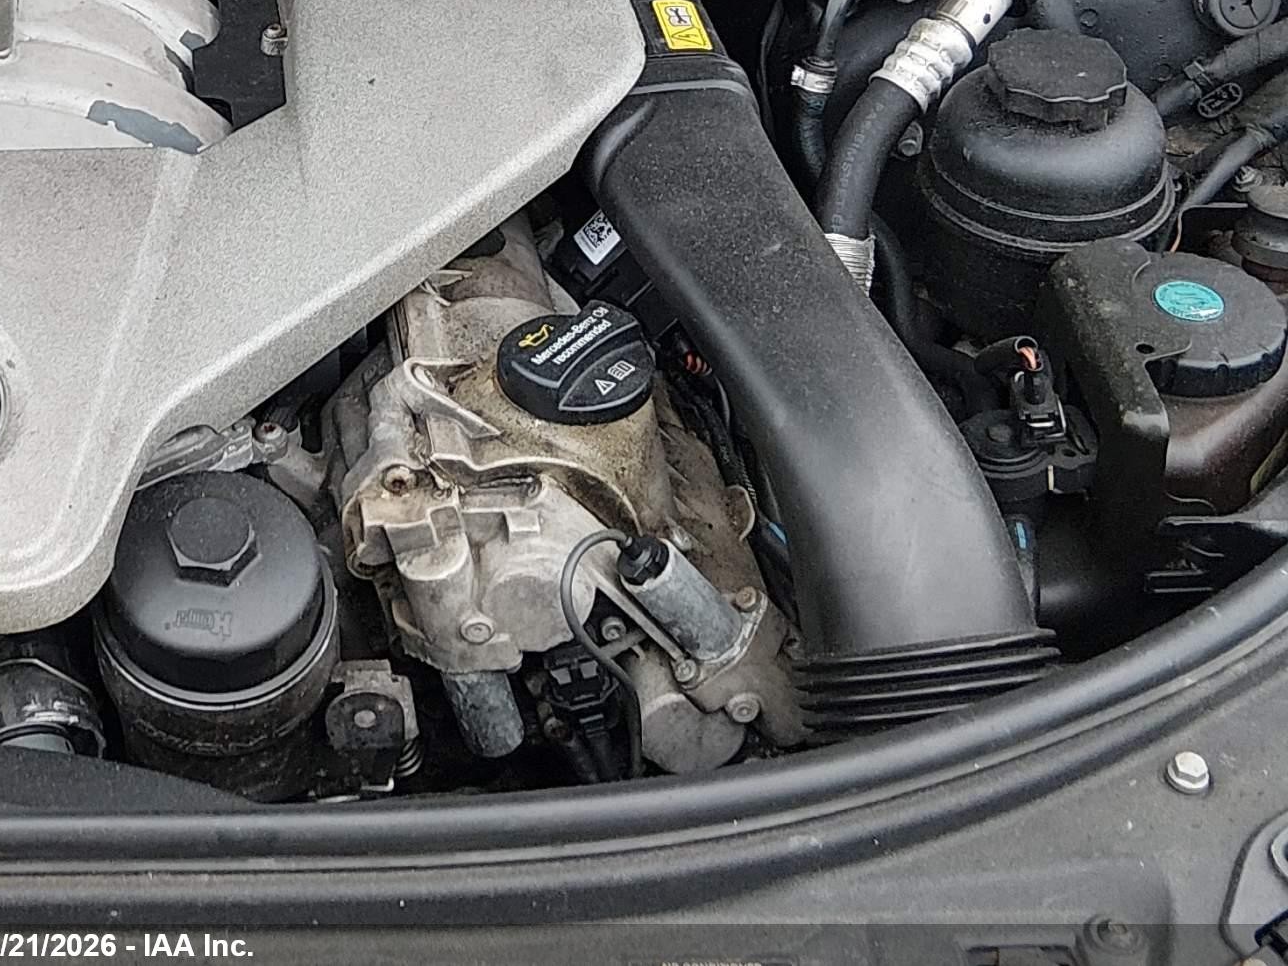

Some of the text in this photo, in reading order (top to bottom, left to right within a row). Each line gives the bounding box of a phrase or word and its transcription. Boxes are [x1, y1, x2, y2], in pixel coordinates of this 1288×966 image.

[530, 305, 610, 366] Mercedes-Benz Oil
[551, 319, 613, 366] recommended
